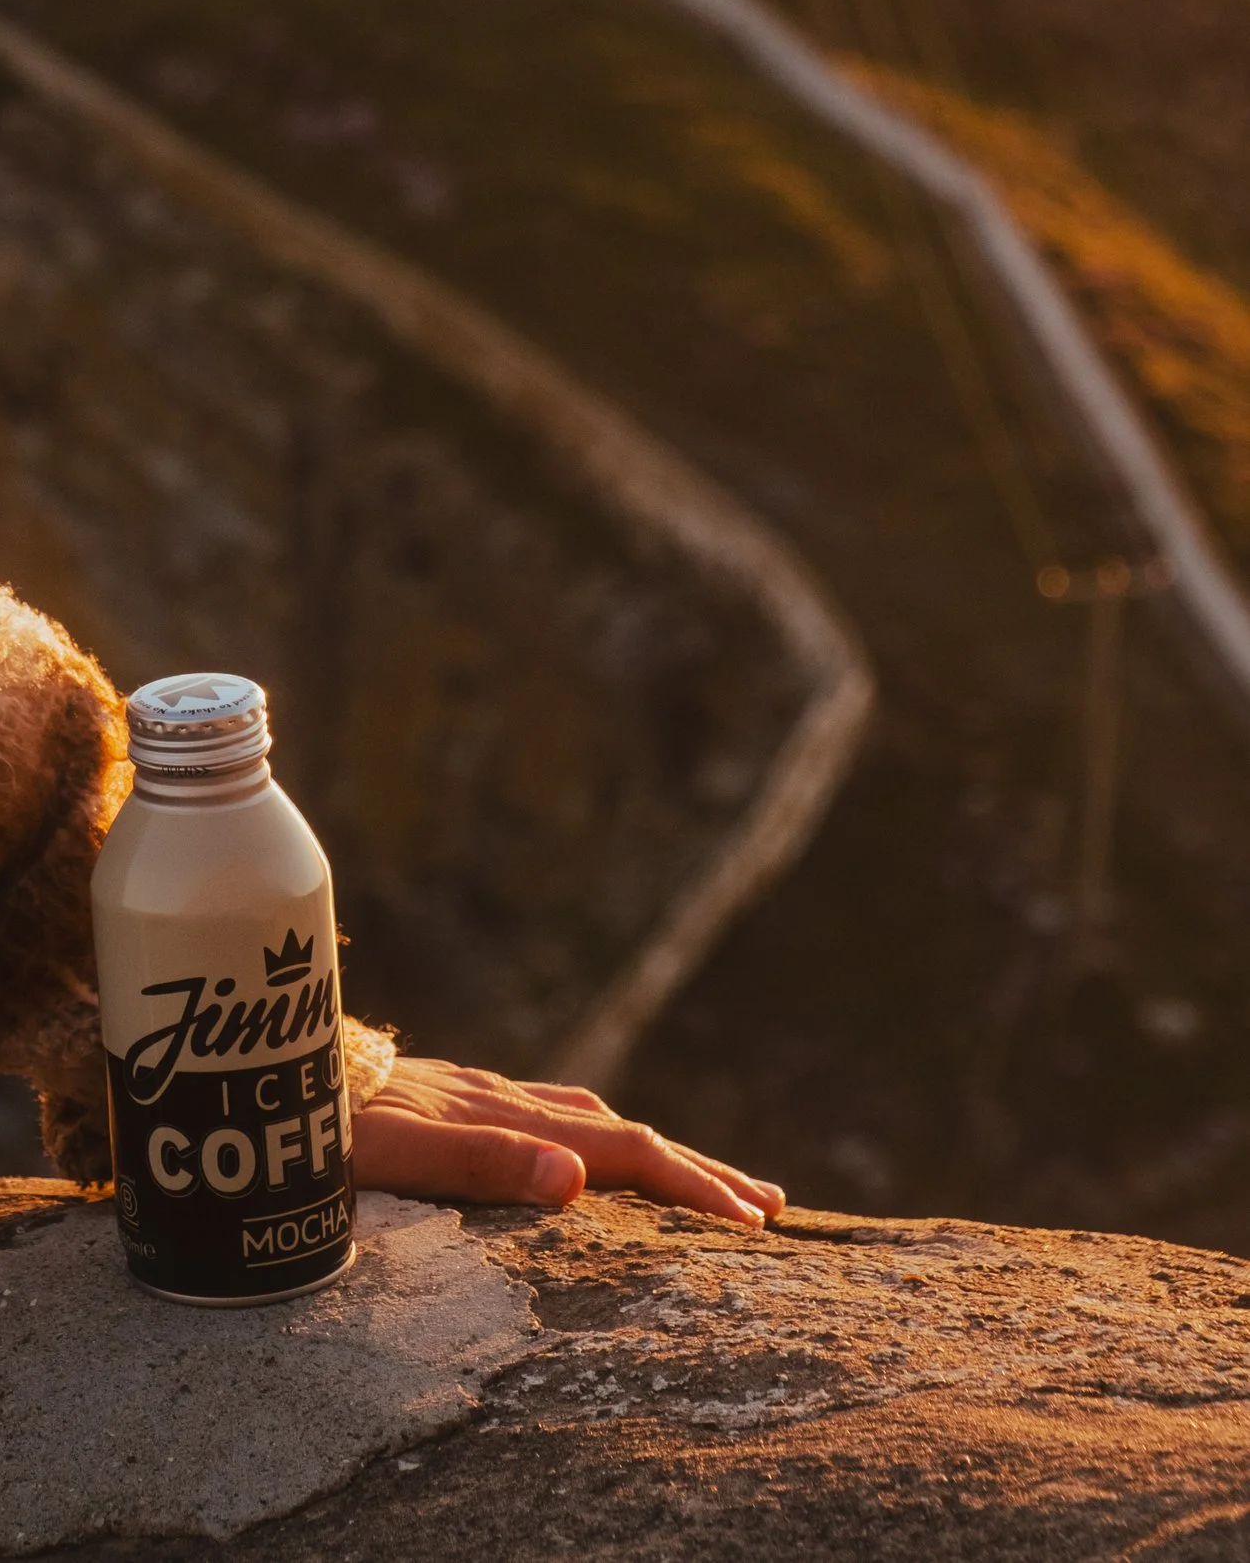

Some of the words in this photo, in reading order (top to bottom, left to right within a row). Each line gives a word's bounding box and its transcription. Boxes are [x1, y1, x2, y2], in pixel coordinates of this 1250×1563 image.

[180, 707, 216, 716] shake
[124, 969, 342, 1106] Jimm
[222, 1045, 343, 1116] ICED
[242, 1200, 350, 1258] MOCHA
